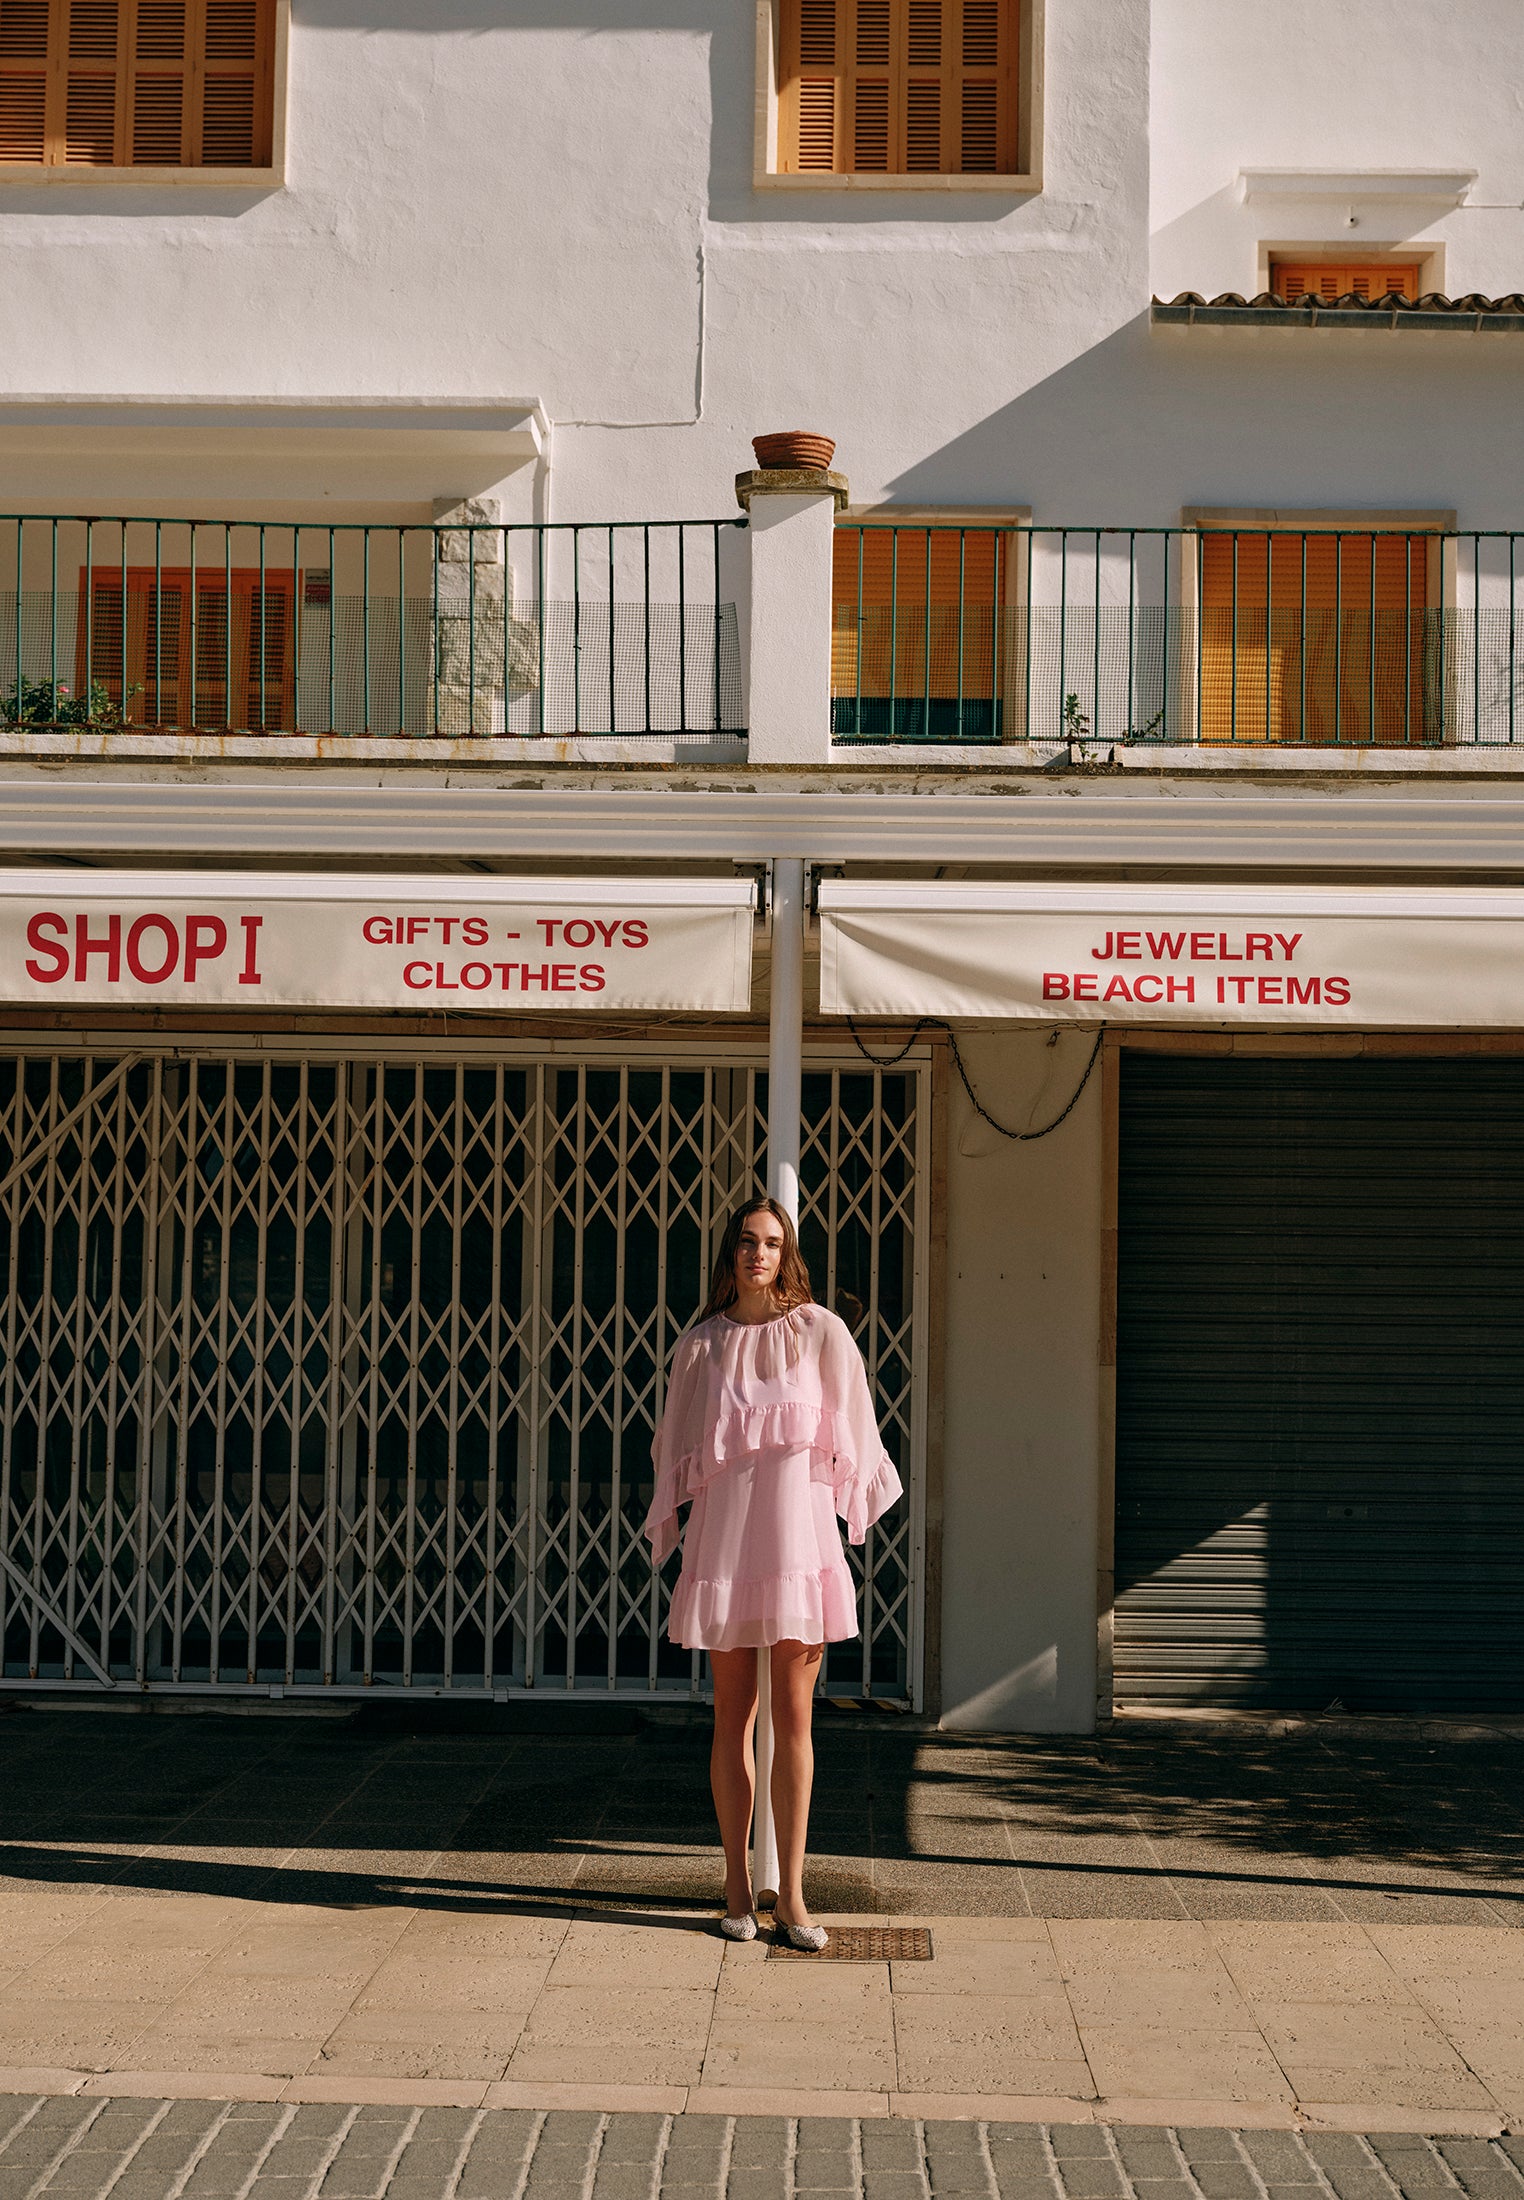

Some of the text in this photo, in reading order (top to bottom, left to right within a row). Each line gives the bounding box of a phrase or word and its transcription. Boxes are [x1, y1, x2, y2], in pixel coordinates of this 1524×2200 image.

[362, 915, 489, 947] GIFTS
[536, 919, 649, 949] TOYS
[1091, 931, 1303, 961] JEWELRY
[403, 961, 606, 993] CLOTHES
[1042, 972, 1351, 1006] BEACH ITEMS
